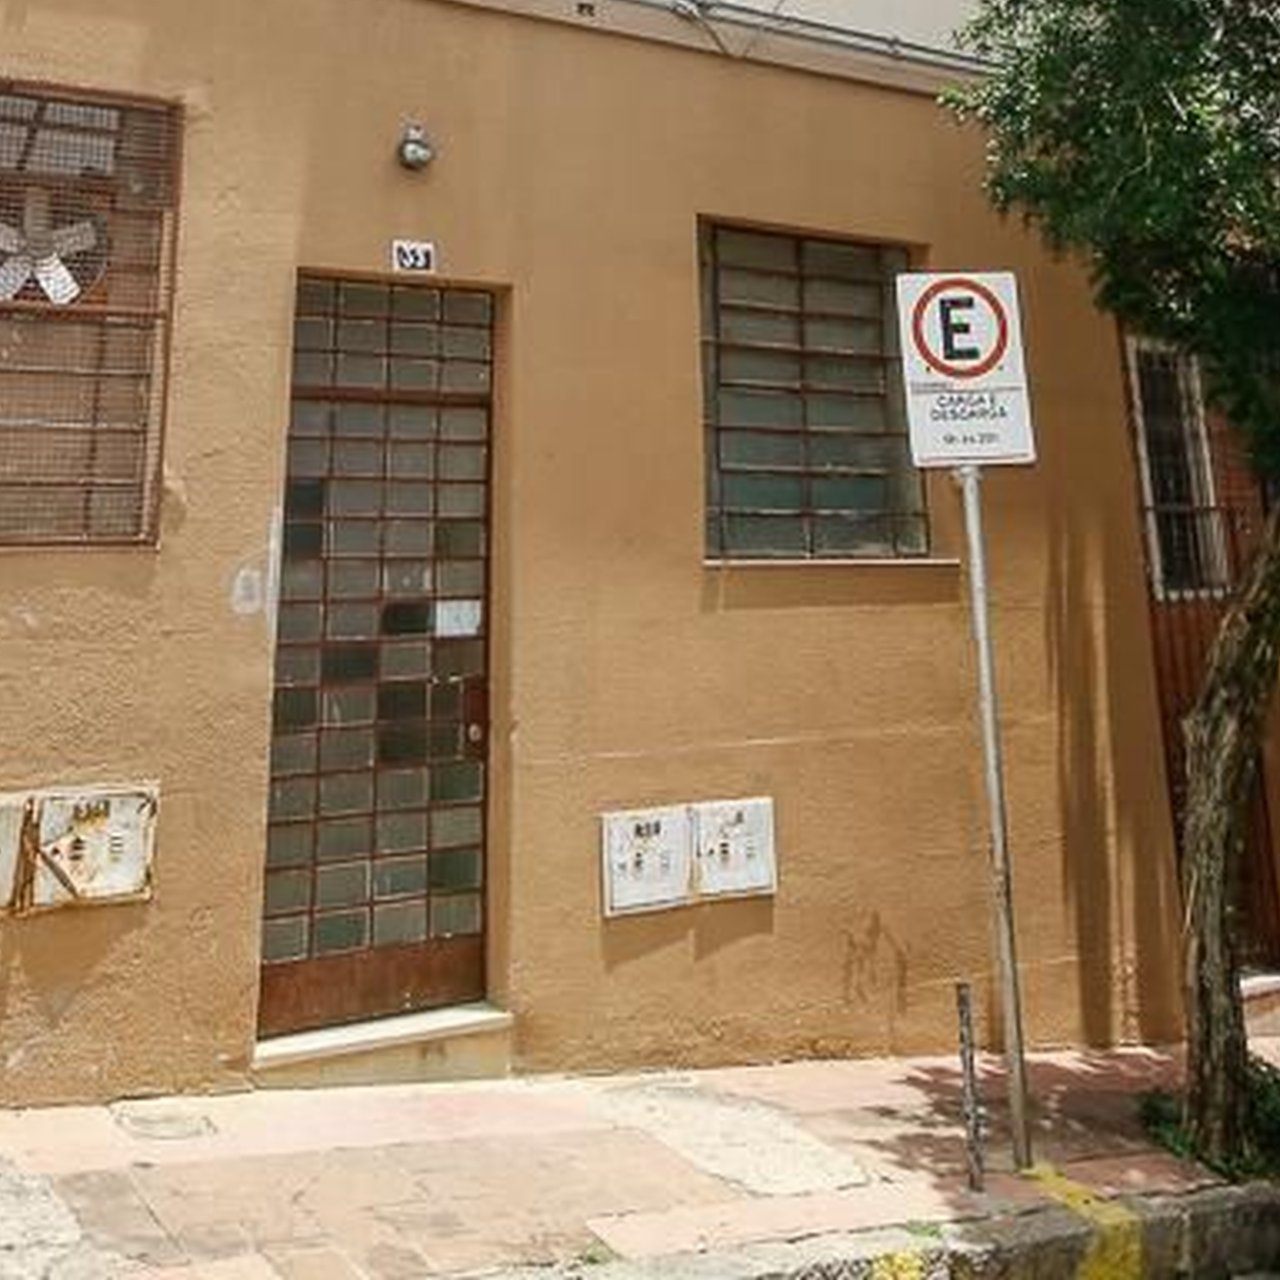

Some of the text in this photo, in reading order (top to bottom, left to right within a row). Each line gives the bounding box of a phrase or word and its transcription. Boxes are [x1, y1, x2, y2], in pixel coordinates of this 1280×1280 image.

[939, 297, 980, 359] E
[937, 394, 985, 408] CARGA
[931, 405, 1007, 420] DESCARGA
